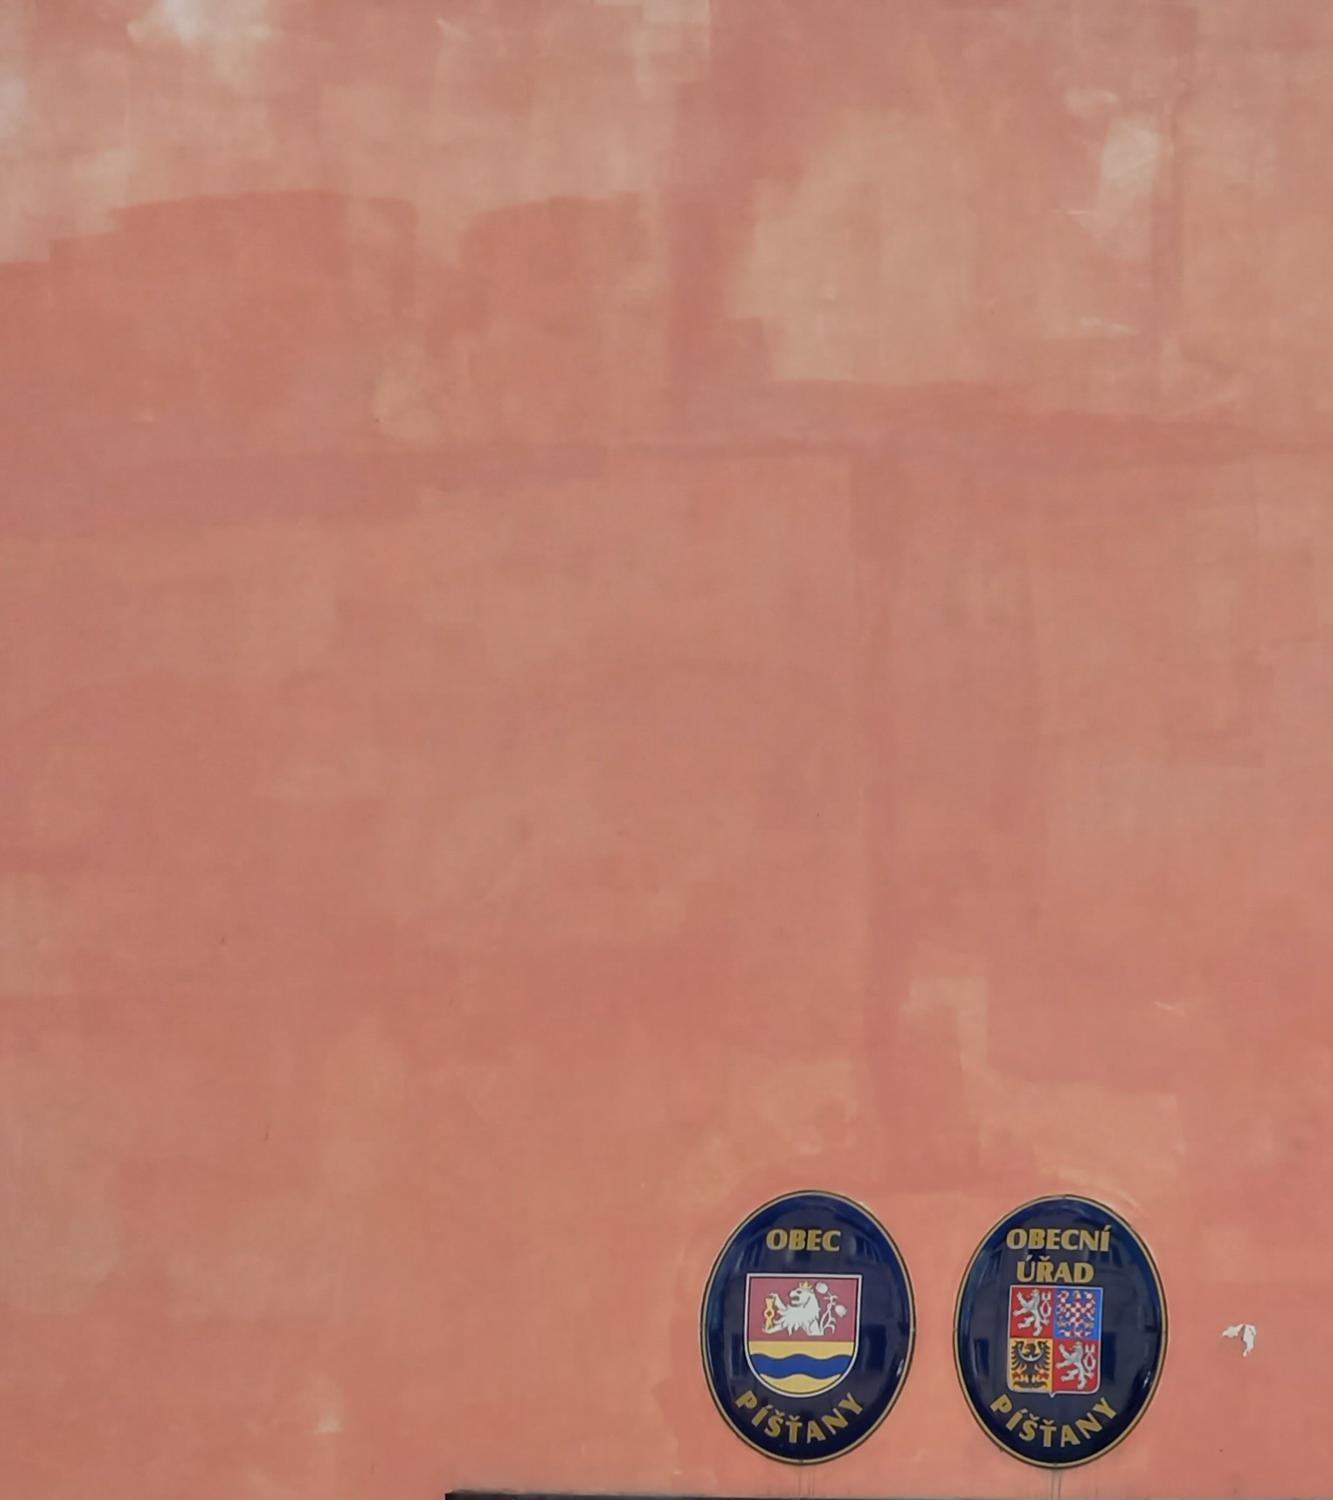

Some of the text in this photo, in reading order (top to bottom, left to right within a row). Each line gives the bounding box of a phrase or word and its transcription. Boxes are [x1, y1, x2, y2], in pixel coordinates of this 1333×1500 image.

[766, 1228, 841, 1252] OBEC
[1006, 1225, 1111, 1251] OBECNÍ
[1016, 1255, 1094, 1283] ÚŘAD
[735, 1390, 863, 1444] PÍŠŤANY
[990, 1393, 1117, 1448] PÍŠŤANY
